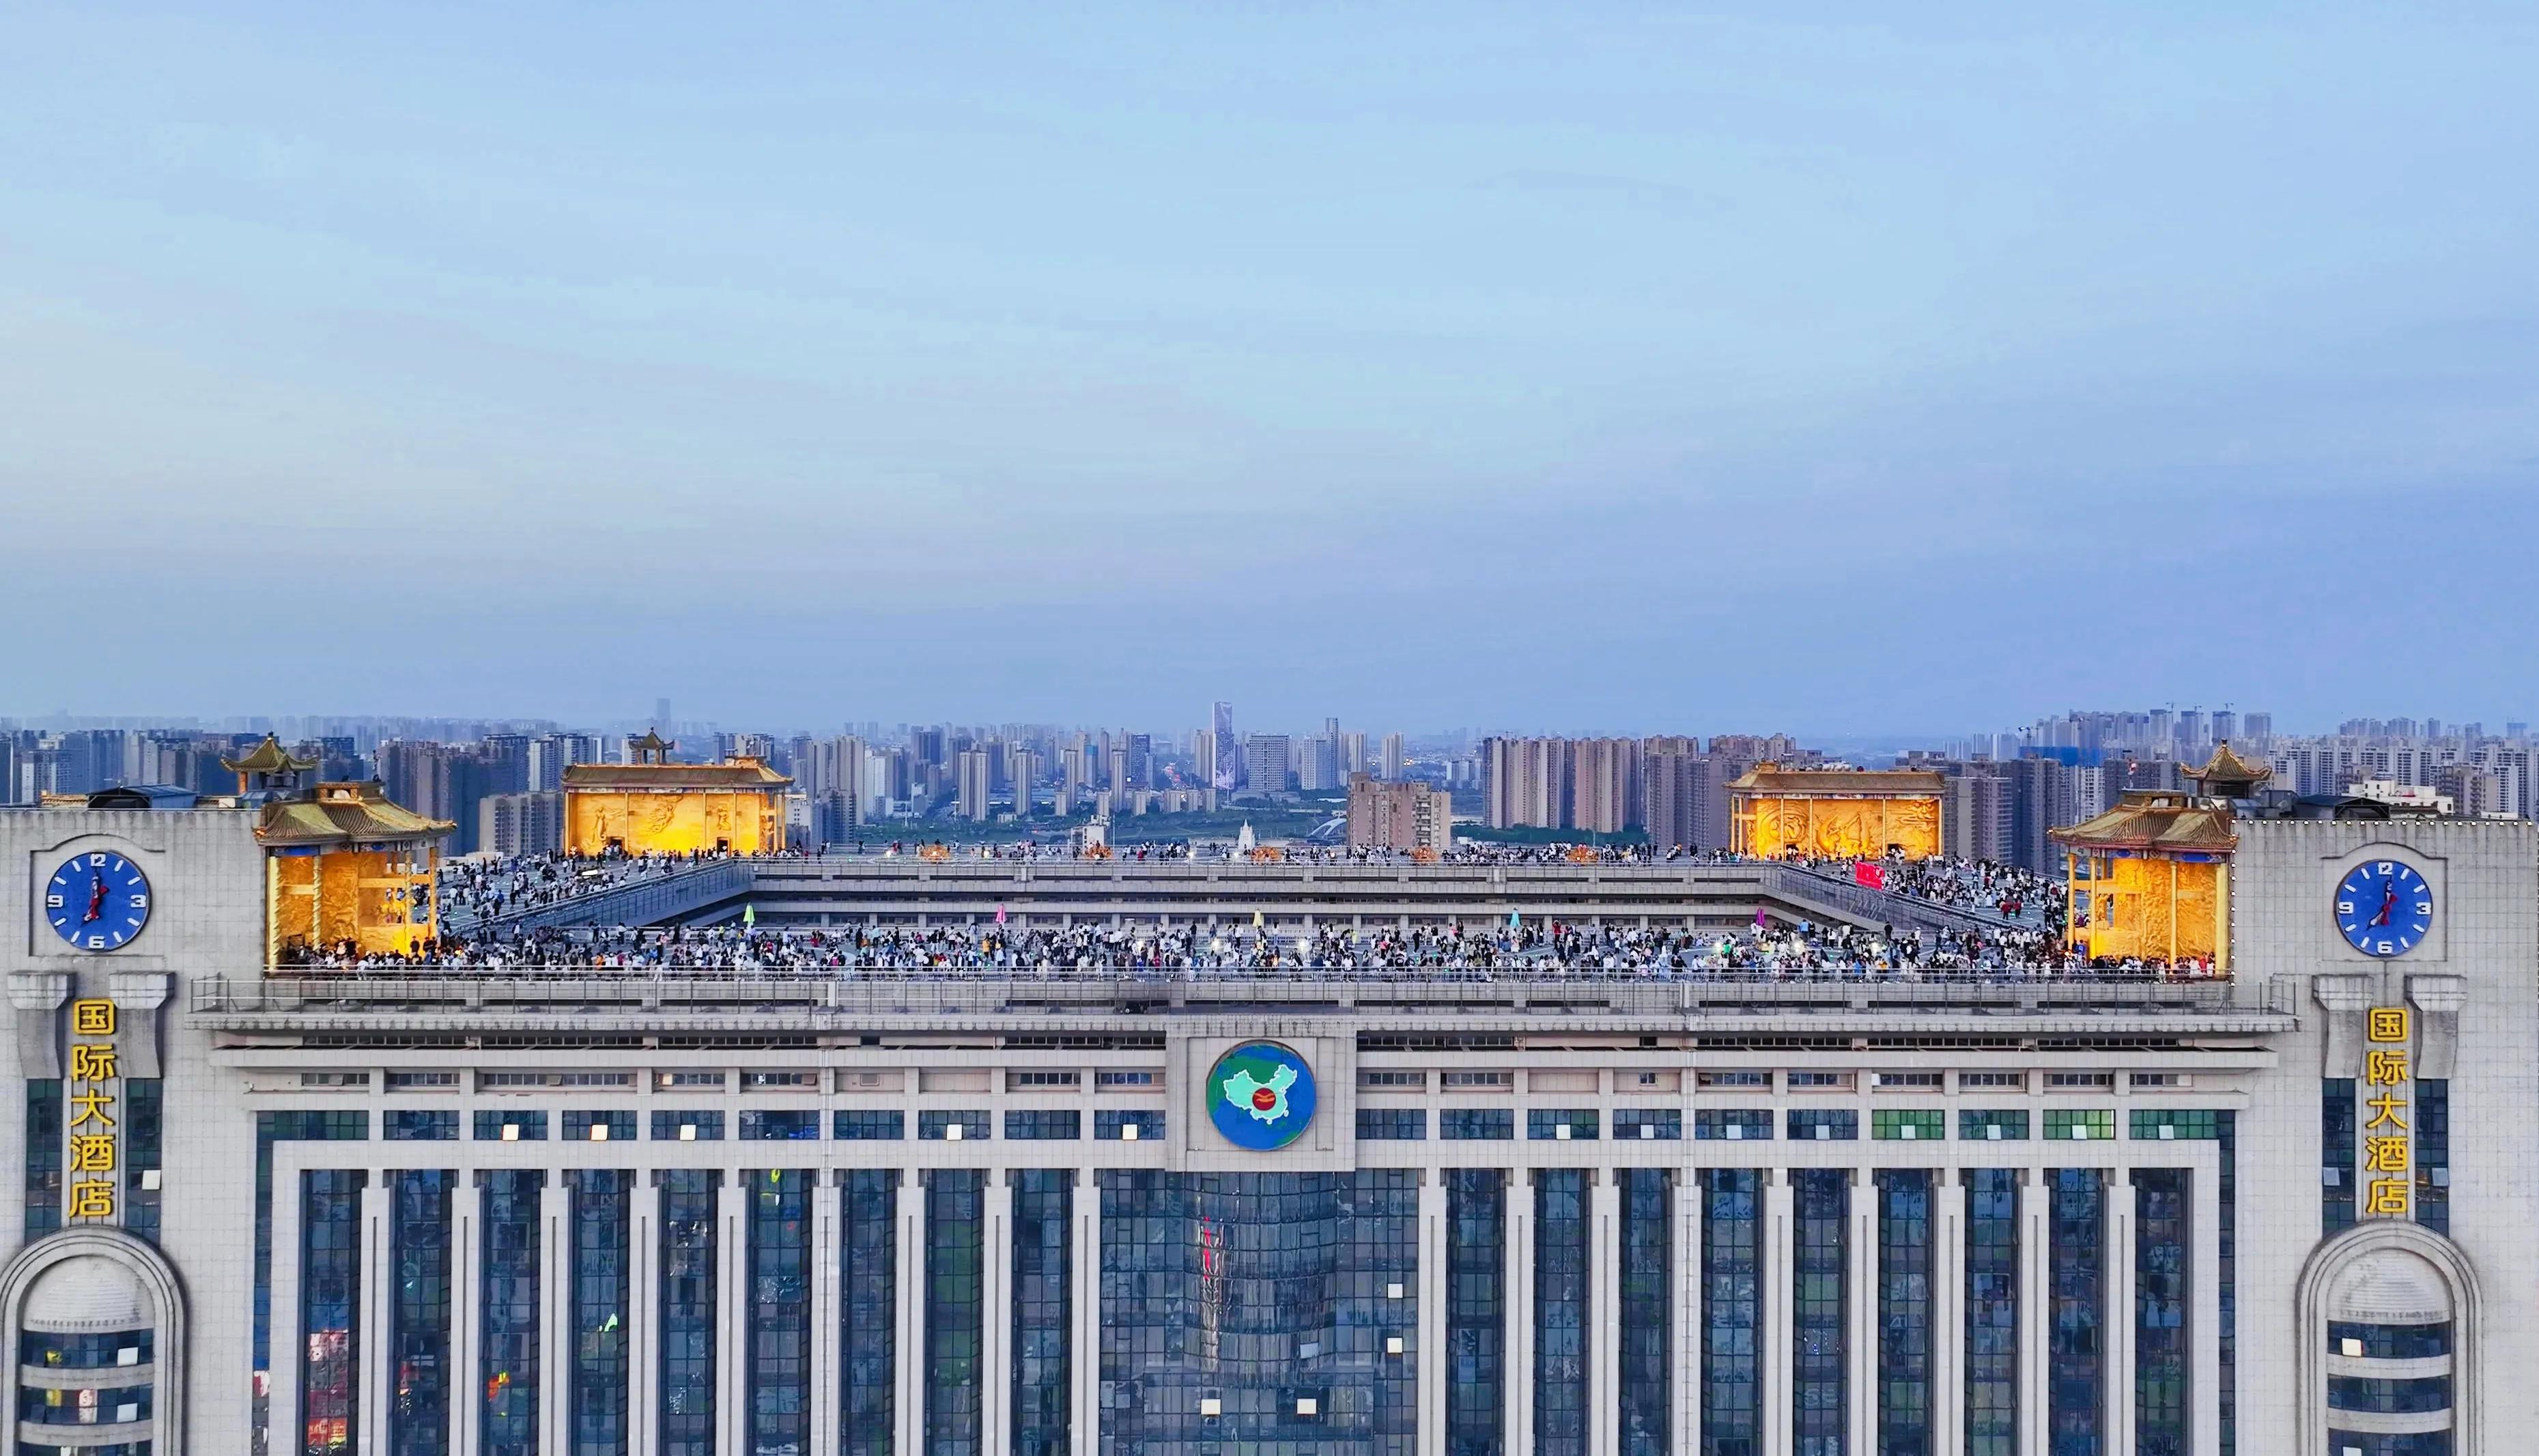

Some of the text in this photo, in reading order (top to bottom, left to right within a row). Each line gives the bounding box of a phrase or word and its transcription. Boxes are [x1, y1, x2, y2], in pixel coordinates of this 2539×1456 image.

[90, 853, 106, 867] 12
[47, 894, 63, 908] 9
[130, 894, 146, 908] 3
[2338, 901, 2354, 914] 9
[2416, 902, 2431, 915] 3
[88, 935, 104, 949] 6
[2377, 941, 2393, 954] 6
[69, 999, 115, 1218] 国际大酒店
[2366, 1008, 2409, 1214] 国际大酒店
